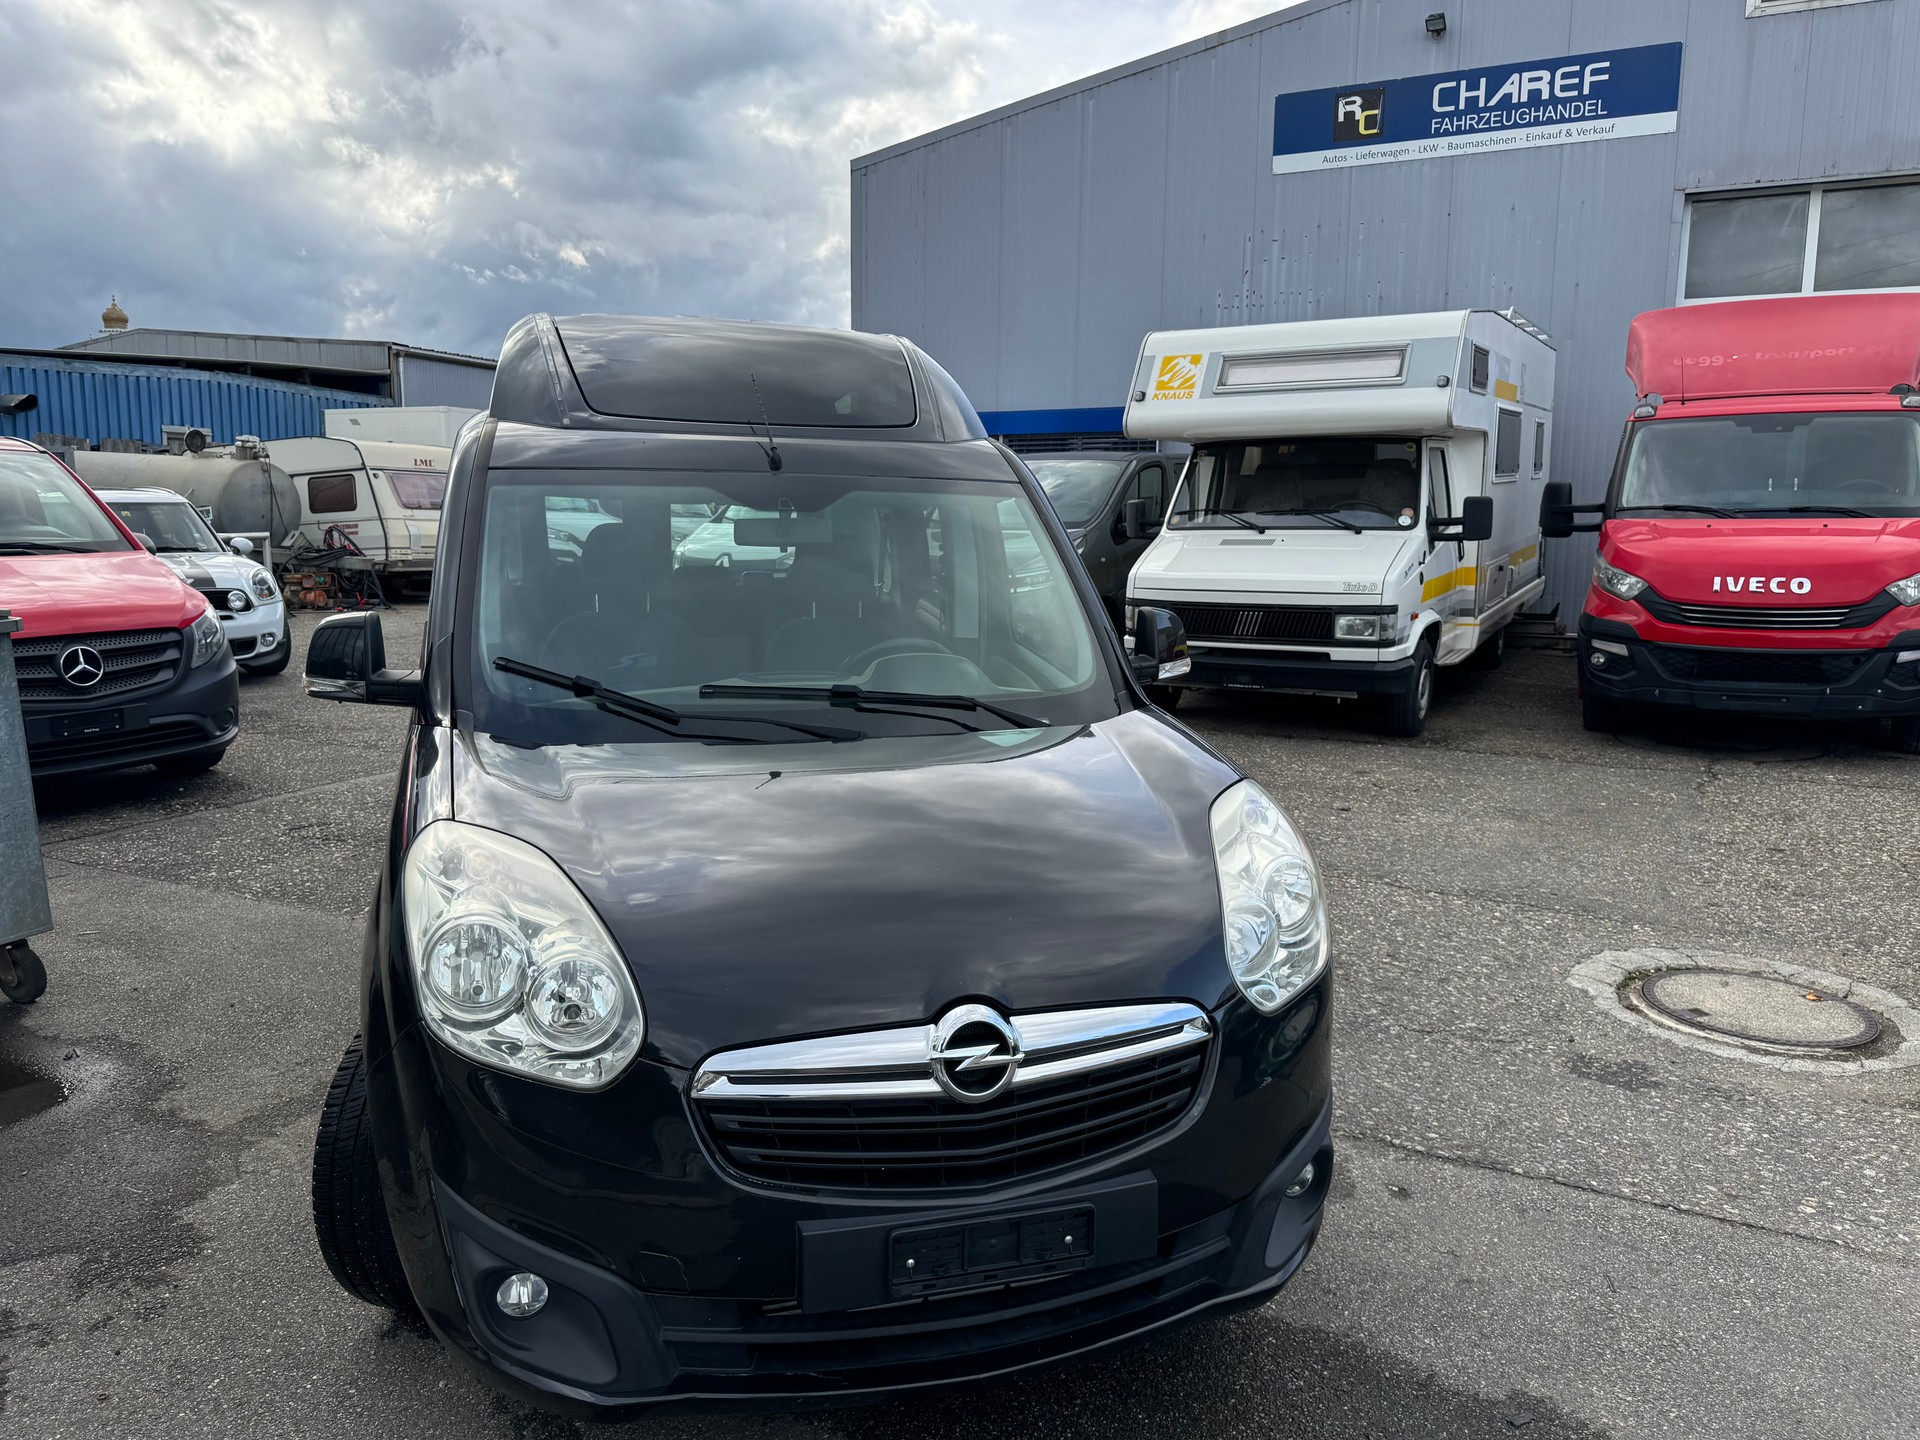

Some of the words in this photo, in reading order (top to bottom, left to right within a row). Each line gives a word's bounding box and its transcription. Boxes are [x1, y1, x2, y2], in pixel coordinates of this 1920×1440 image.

[1432, 61, 1611, 113] CHAREF
[1431, 99, 1608, 134] FAHRZEUGHANDEL
[1322, 154, 1348, 164] Autos
[1355, 147, 1410, 161] Lieferwagen
[1418, 143, 1439, 154] LKW
[1447, 135, 1517, 150] Baumaschinen
[1526, 128, 1563, 142] Einkauf
[1564, 128, 1573, 137] &
[1576, 123, 1616, 136] Verkauf
[1152, 390, 1195, 401] KNAUS
[1343, 582, 1368, 592] Turbo
[1368, 582, 1378, 593] D
[1712, 576, 1812, 595] IVECO
